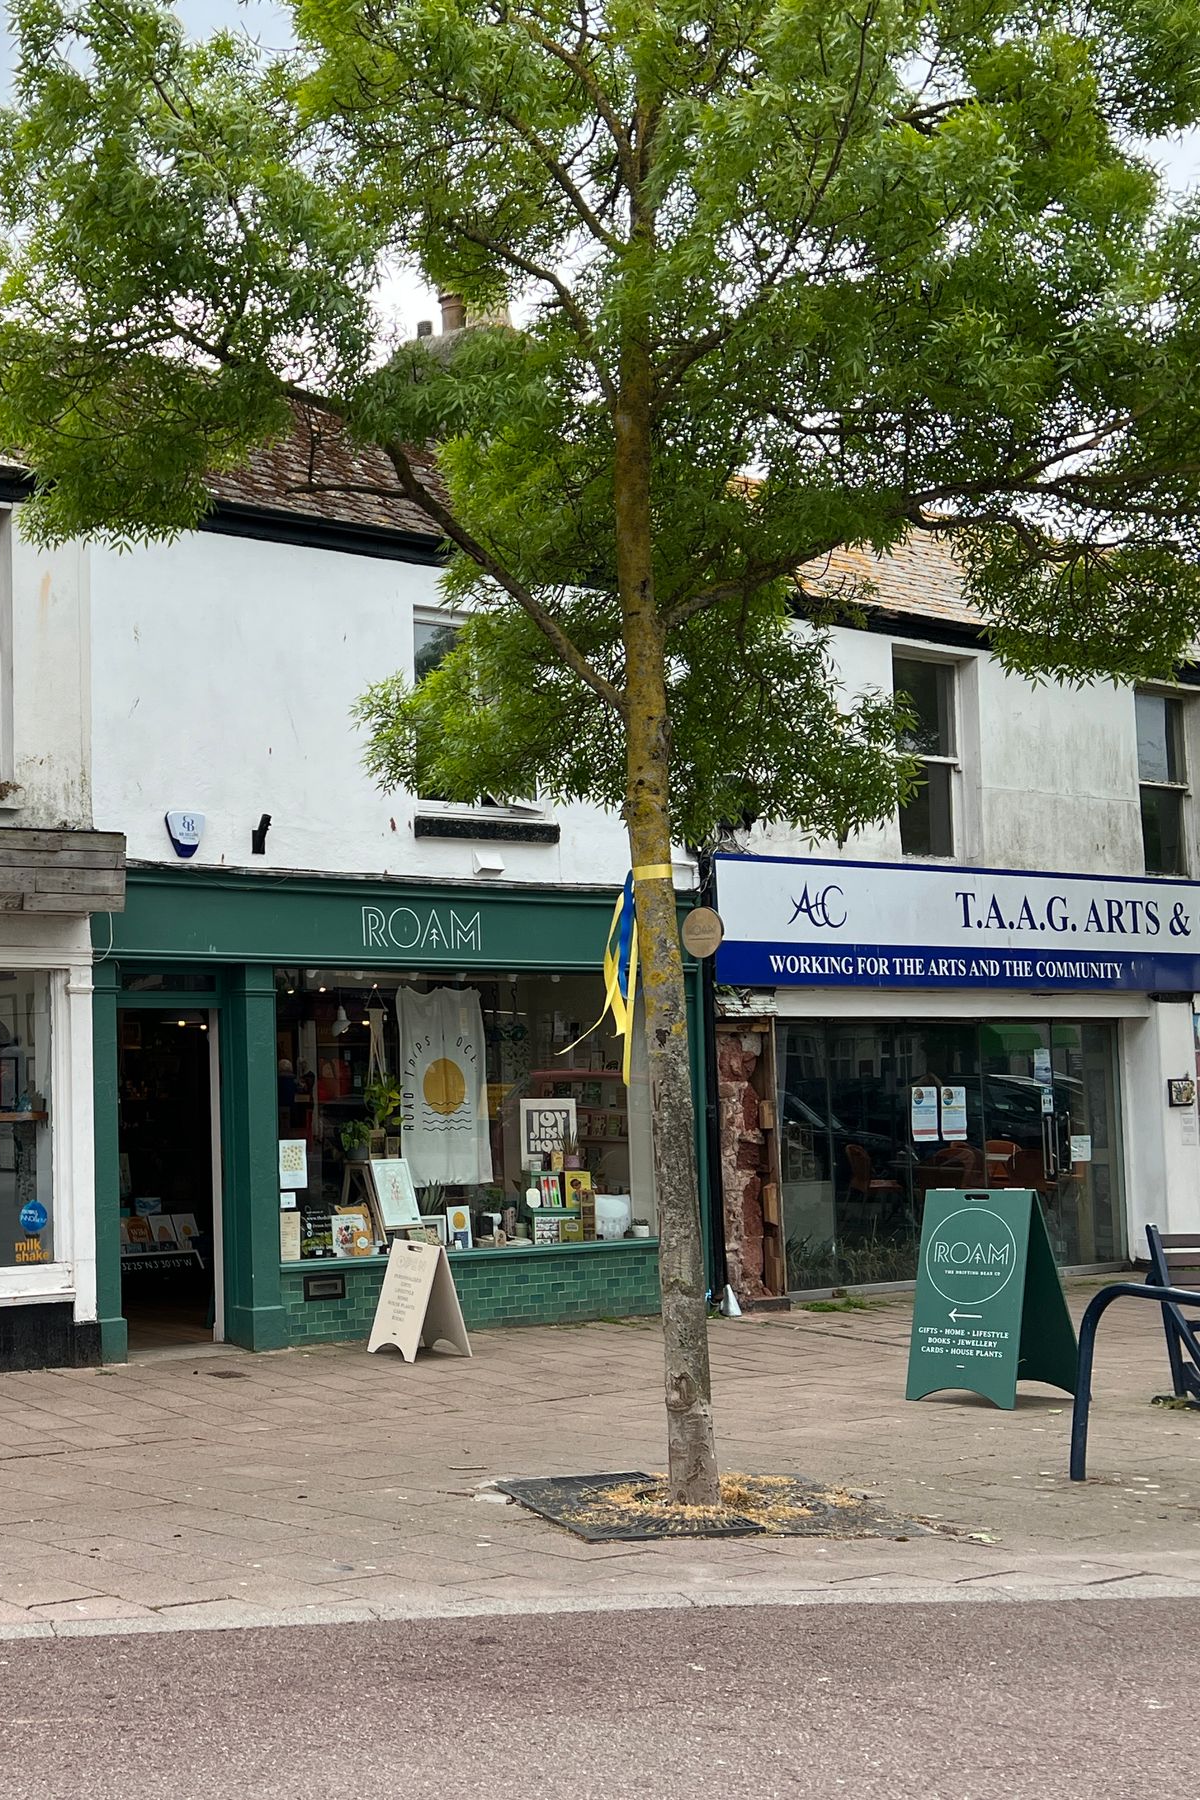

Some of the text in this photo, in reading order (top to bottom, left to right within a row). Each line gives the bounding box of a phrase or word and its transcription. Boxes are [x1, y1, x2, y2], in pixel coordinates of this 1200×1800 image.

[955, 892, 1192, 936] T.A.A.G. ARTS &
[361, 906, 481, 951] ROAM
[769, 955, 1123, 979] WORKING FOR THE ARTS AND THE COMMUNITY
[404, 1035, 431, 1077] TRIPS
[403, 1092, 415, 1131] ROAD
[529, 1111, 567, 1139] JOY
[15, 1239, 41, 1251] milk
[15, 1251, 49, 1262] shake
[934, 1241, 1009, 1265] ROAM
[918, 1326, 1009, 1339] GIFTS HOME LIFESTYLE
[927, 1337, 998, 1348] BOOKS JEWELLERY
[950, 1348, 974, 1356] HOUSE
[975, 1350, 1003, 1358] PLANTS
